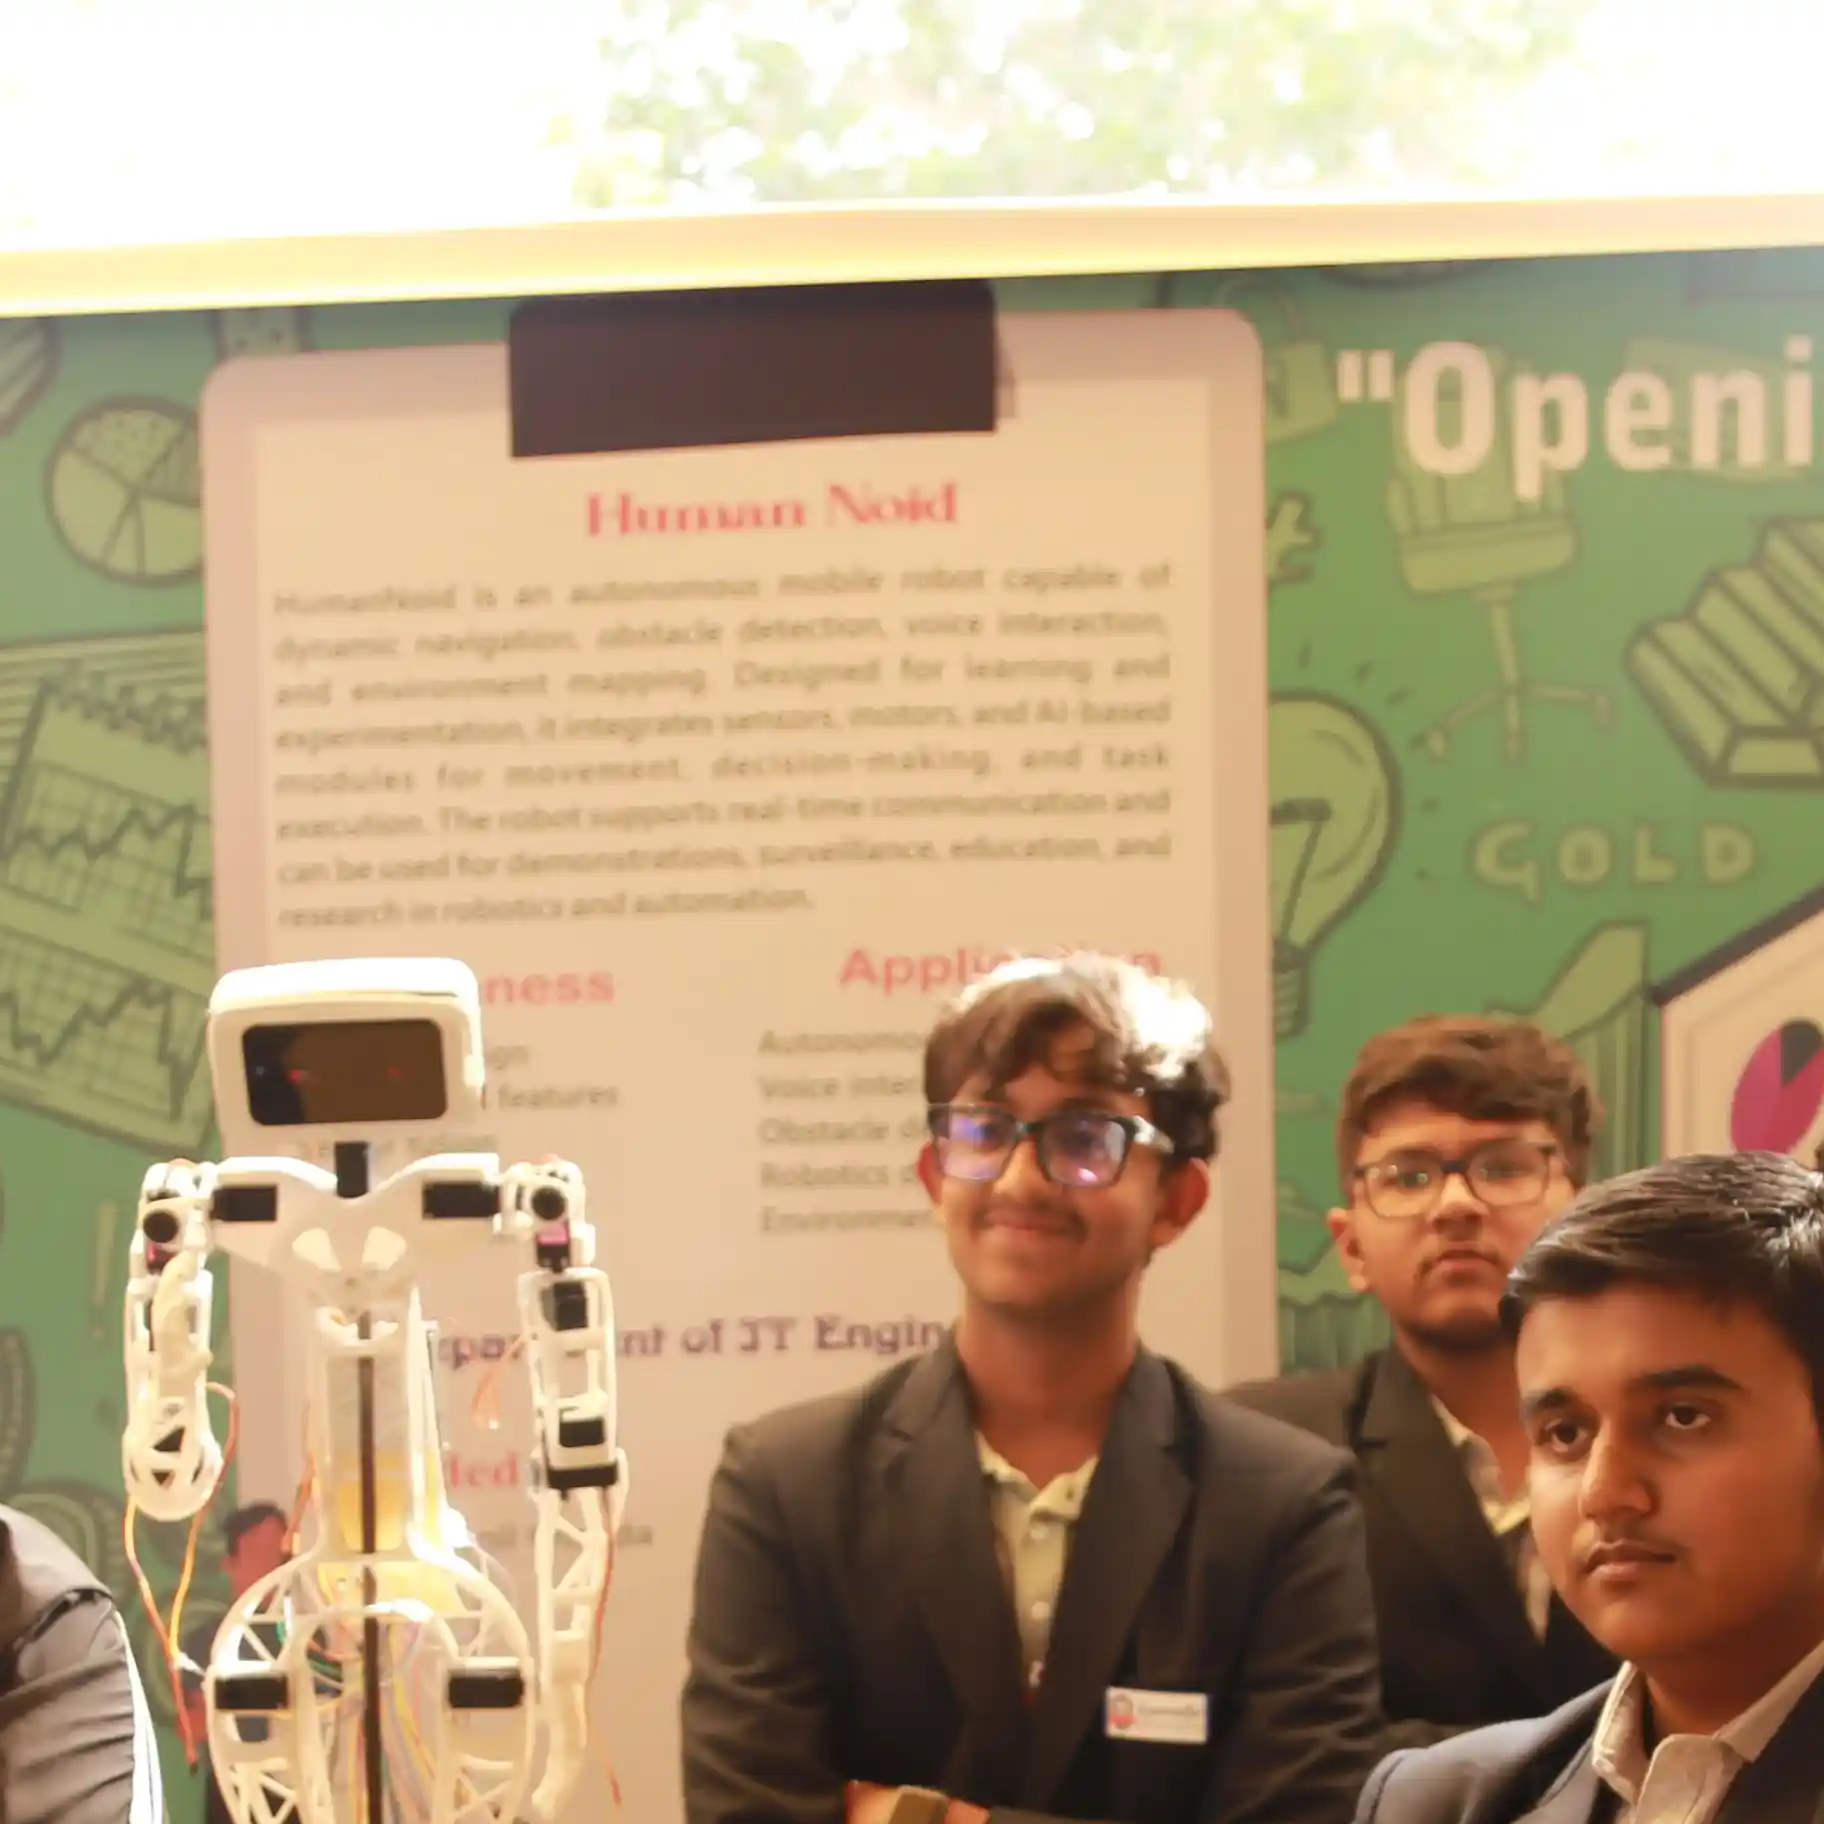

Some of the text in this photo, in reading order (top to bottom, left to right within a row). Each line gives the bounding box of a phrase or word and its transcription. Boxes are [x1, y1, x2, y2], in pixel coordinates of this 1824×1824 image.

[587, 480, 958, 536] Human Noid
[1468, 819, 1756, 904] GOLD
[680, 1317, 724, 1355] of
